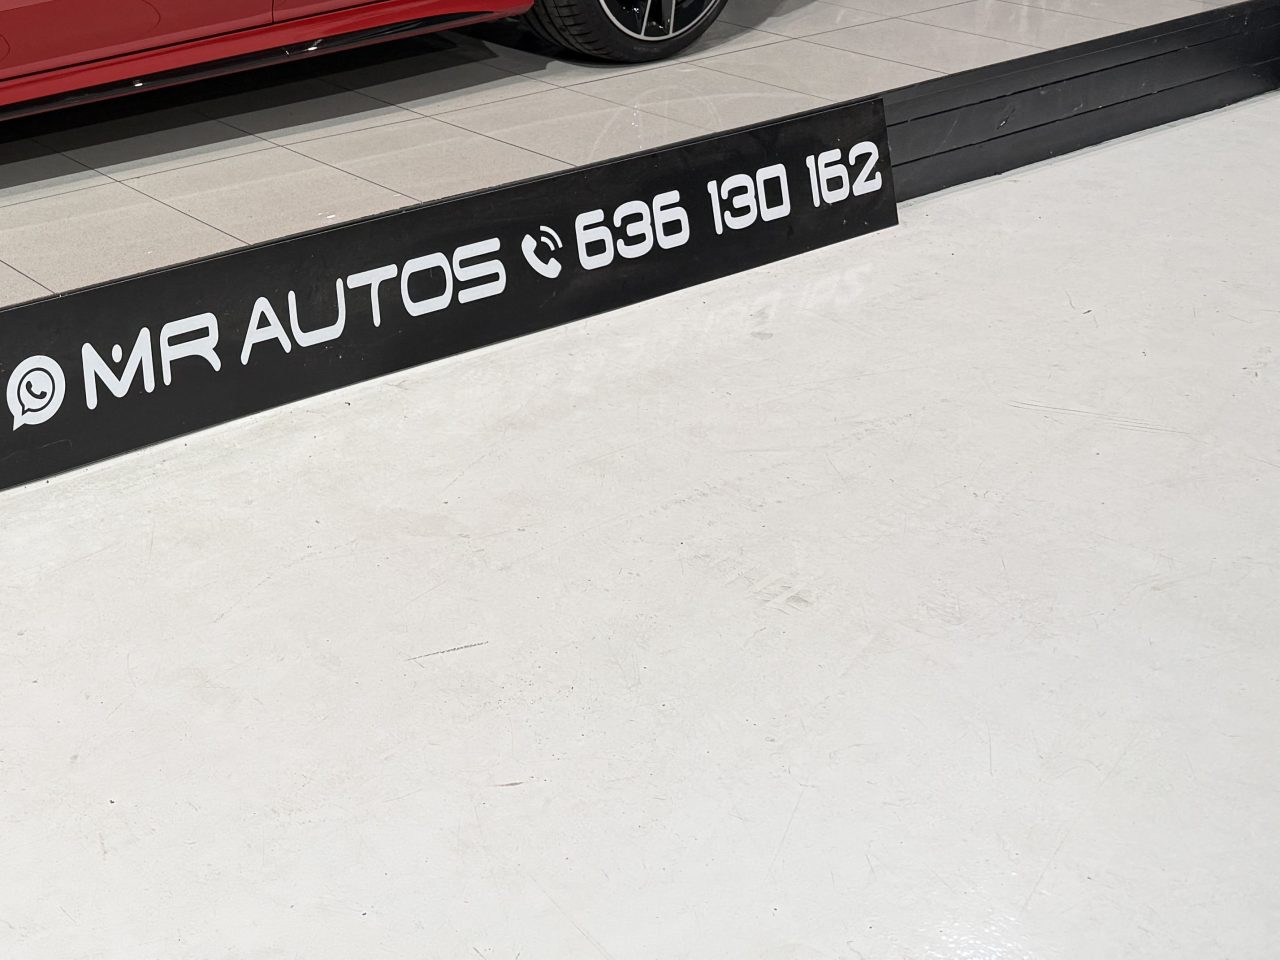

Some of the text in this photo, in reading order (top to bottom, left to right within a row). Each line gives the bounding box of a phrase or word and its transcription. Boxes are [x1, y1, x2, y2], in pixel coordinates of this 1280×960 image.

[81, 140, 883, 410] MR AUTOS 636 130 162
